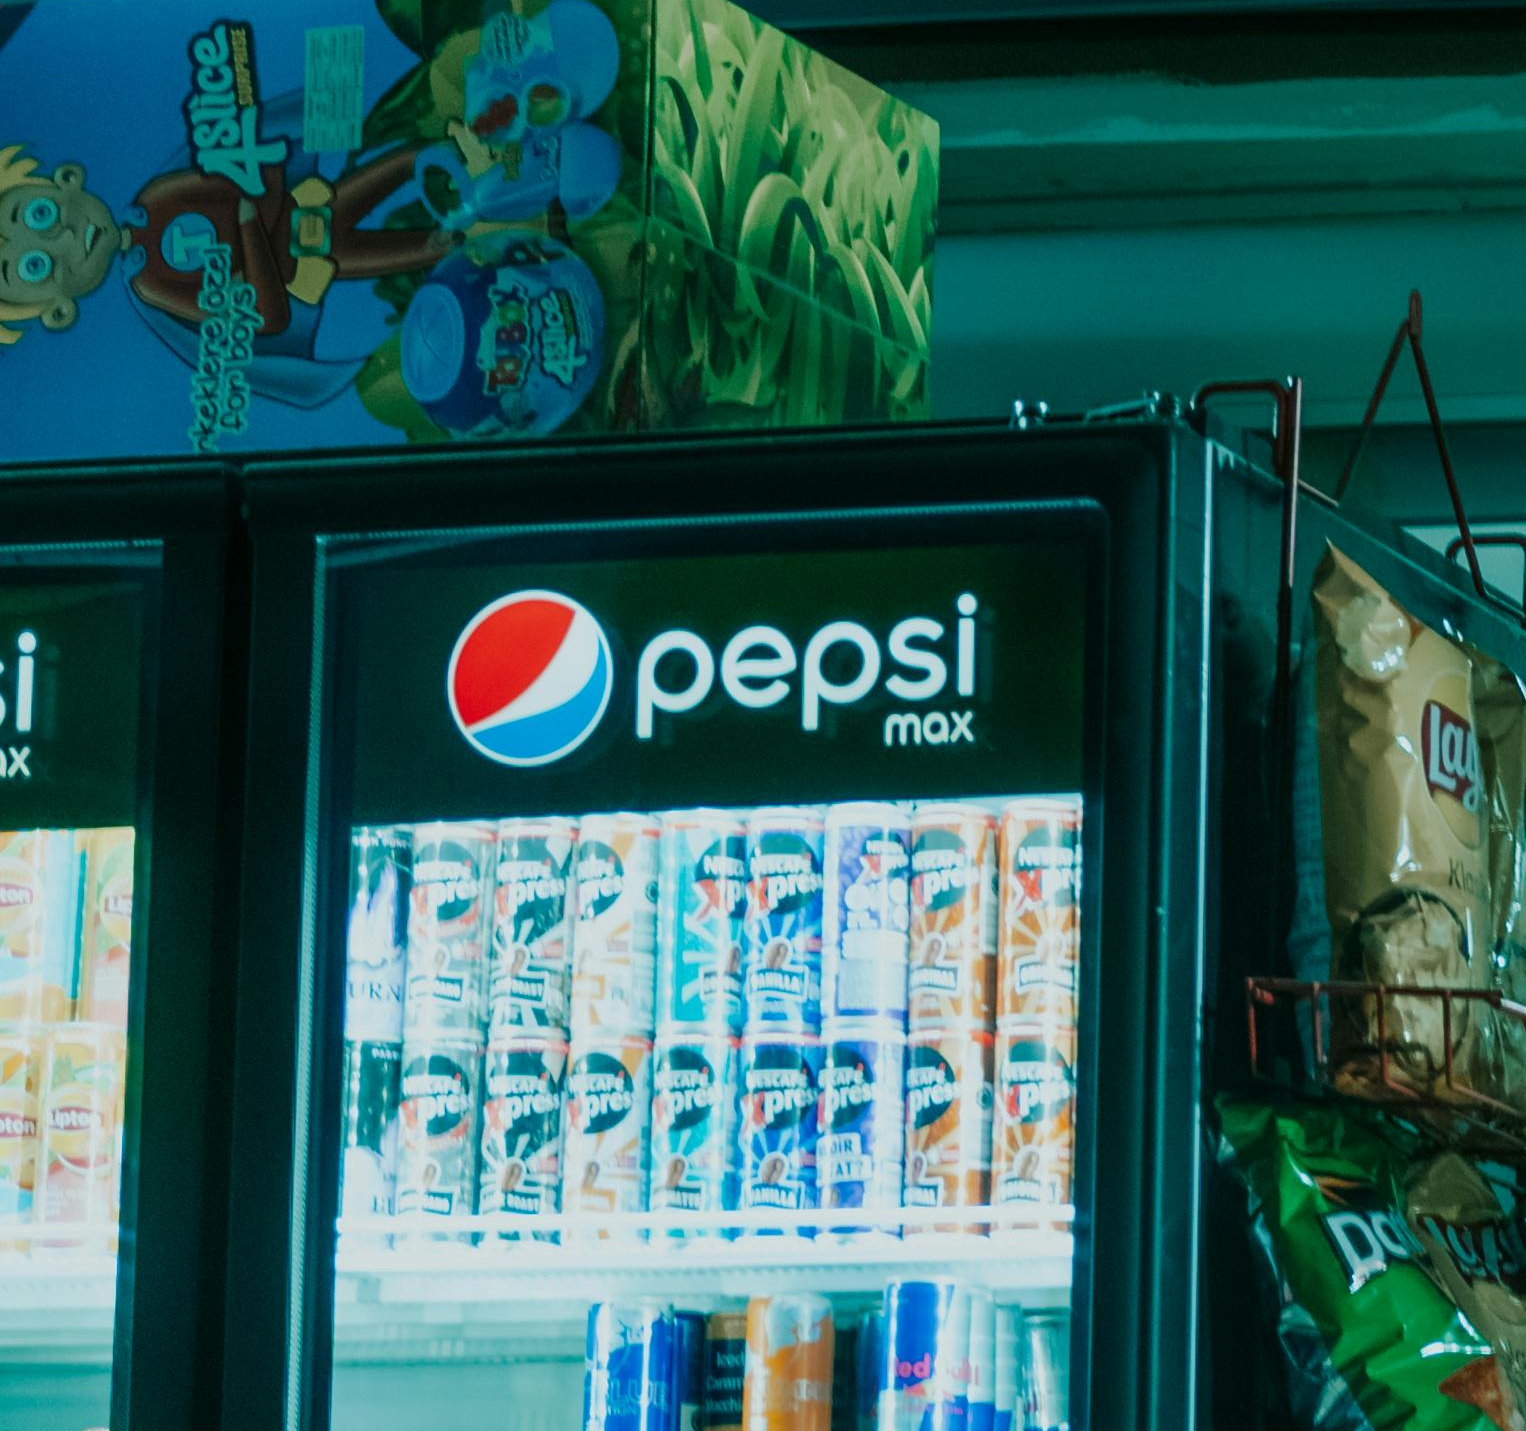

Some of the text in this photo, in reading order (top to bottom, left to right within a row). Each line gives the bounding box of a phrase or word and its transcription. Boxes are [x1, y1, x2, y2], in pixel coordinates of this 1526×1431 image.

[220, 285, 264, 432] for boys
[637, 594, 978, 739] pepsi
[885, 710, 975, 746] max
